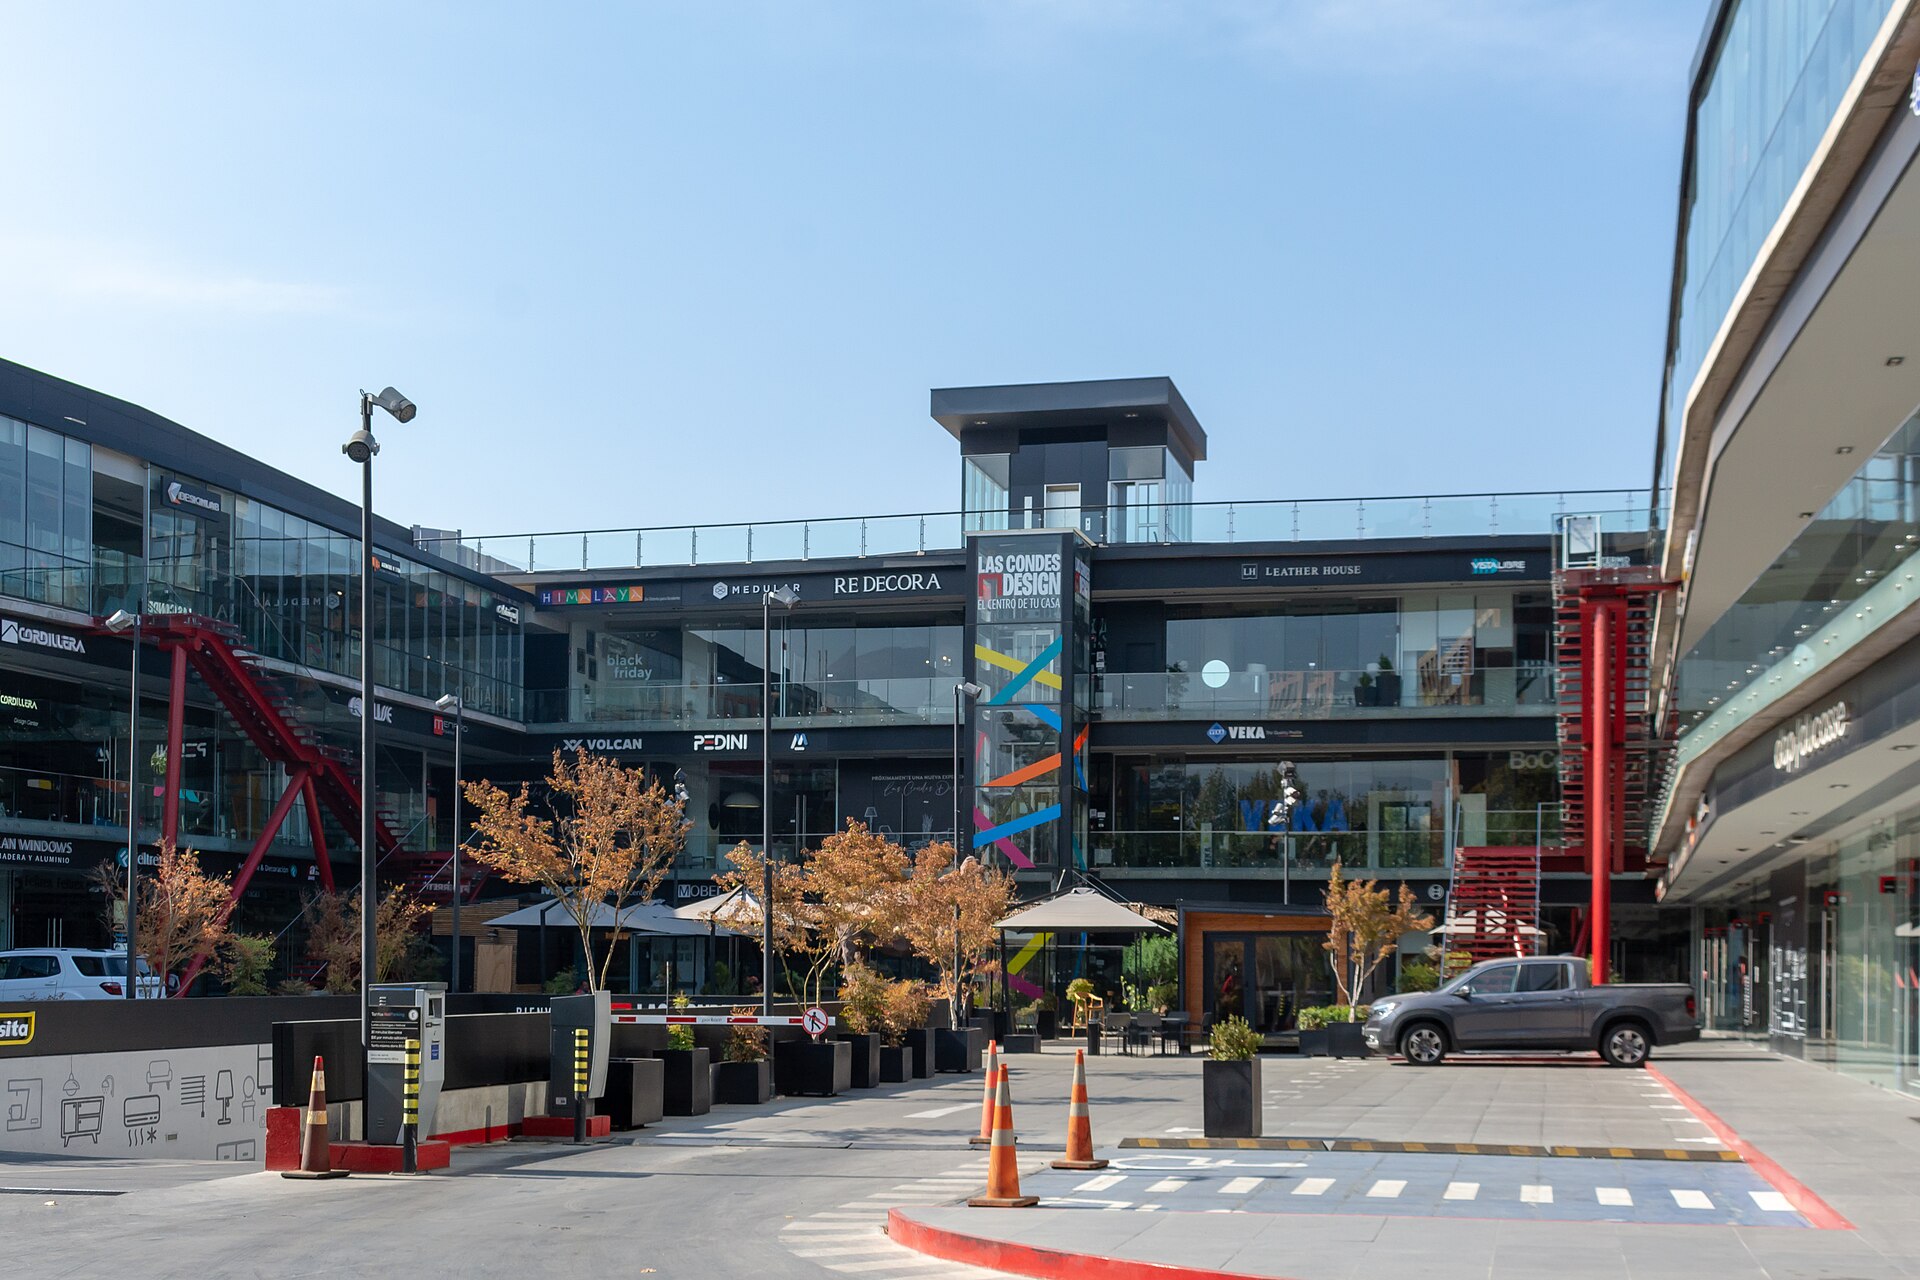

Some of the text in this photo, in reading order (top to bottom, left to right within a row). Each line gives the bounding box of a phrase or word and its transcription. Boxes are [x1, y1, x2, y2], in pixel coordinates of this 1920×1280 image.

[977, 553, 1061, 574] LAS CONDES
[1265, 567, 1320, 577] LEATHER
[1322, 565, 1362, 576] HOUSE
[732, 583, 801, 595] MEDULR
[834, 573, 942, 594] RE DECORA
[1002, 571, 1061, 597] DESIGN
[542, 586, 643, 603] HIMALAYA
[977, 597, 1061, 610] EL CENTRO DE TU CASA
[18, 626, 86, 654] CORDILLERA
[607, 653, 643, 666] black
[613, 666, 653, 681] friday
[0, 694, 38, 710] CORDILLERA
[1228, 726, 1266, 739] VEKA
[587, 738, 644, 751] VOLCAN
[694, 734, 749, 751] PEDINI
[0, 837, 73, 854] AN WINDOWS
[34, 855, 70, 864] ALUMINIO
